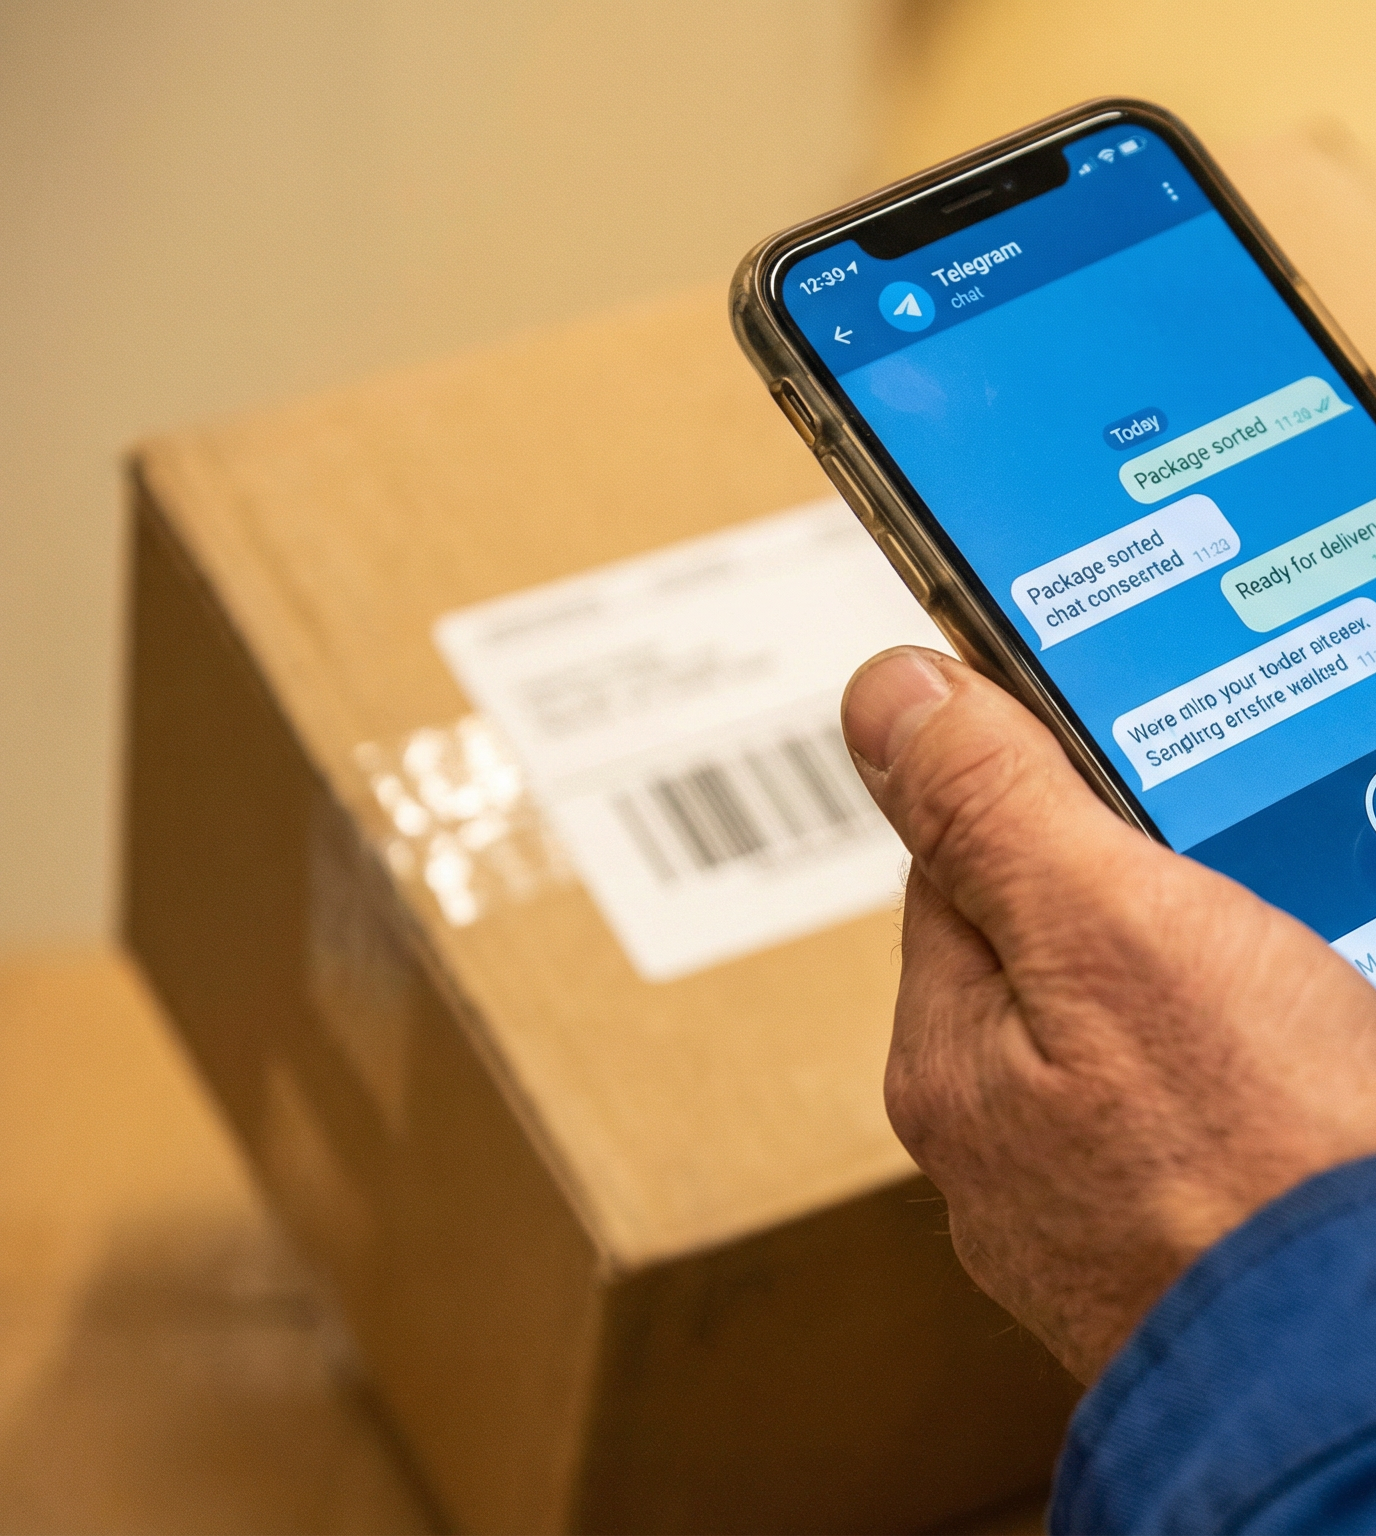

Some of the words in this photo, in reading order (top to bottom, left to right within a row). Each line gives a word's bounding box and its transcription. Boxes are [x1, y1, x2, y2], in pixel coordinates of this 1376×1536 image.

[931, 241, 1022, 286] Telegram
[799, 267, 846, 295] 12:39
[951, 286, 985, 310] chat
[1110, 414, 1160, 445] Today
[1133, 446, 1210, 490] Package
[1212, 416, 1268, 454] sorted
[1027, 561, 1106, 605] Package
[1108, 529, 1164, 568] sorted
[1235, 561, 1291, 599] Ready
[1291, 551, 1318, 578] for
[1045, 598, 1086, 628] chat
[1219, 676, 1258, 704] your
